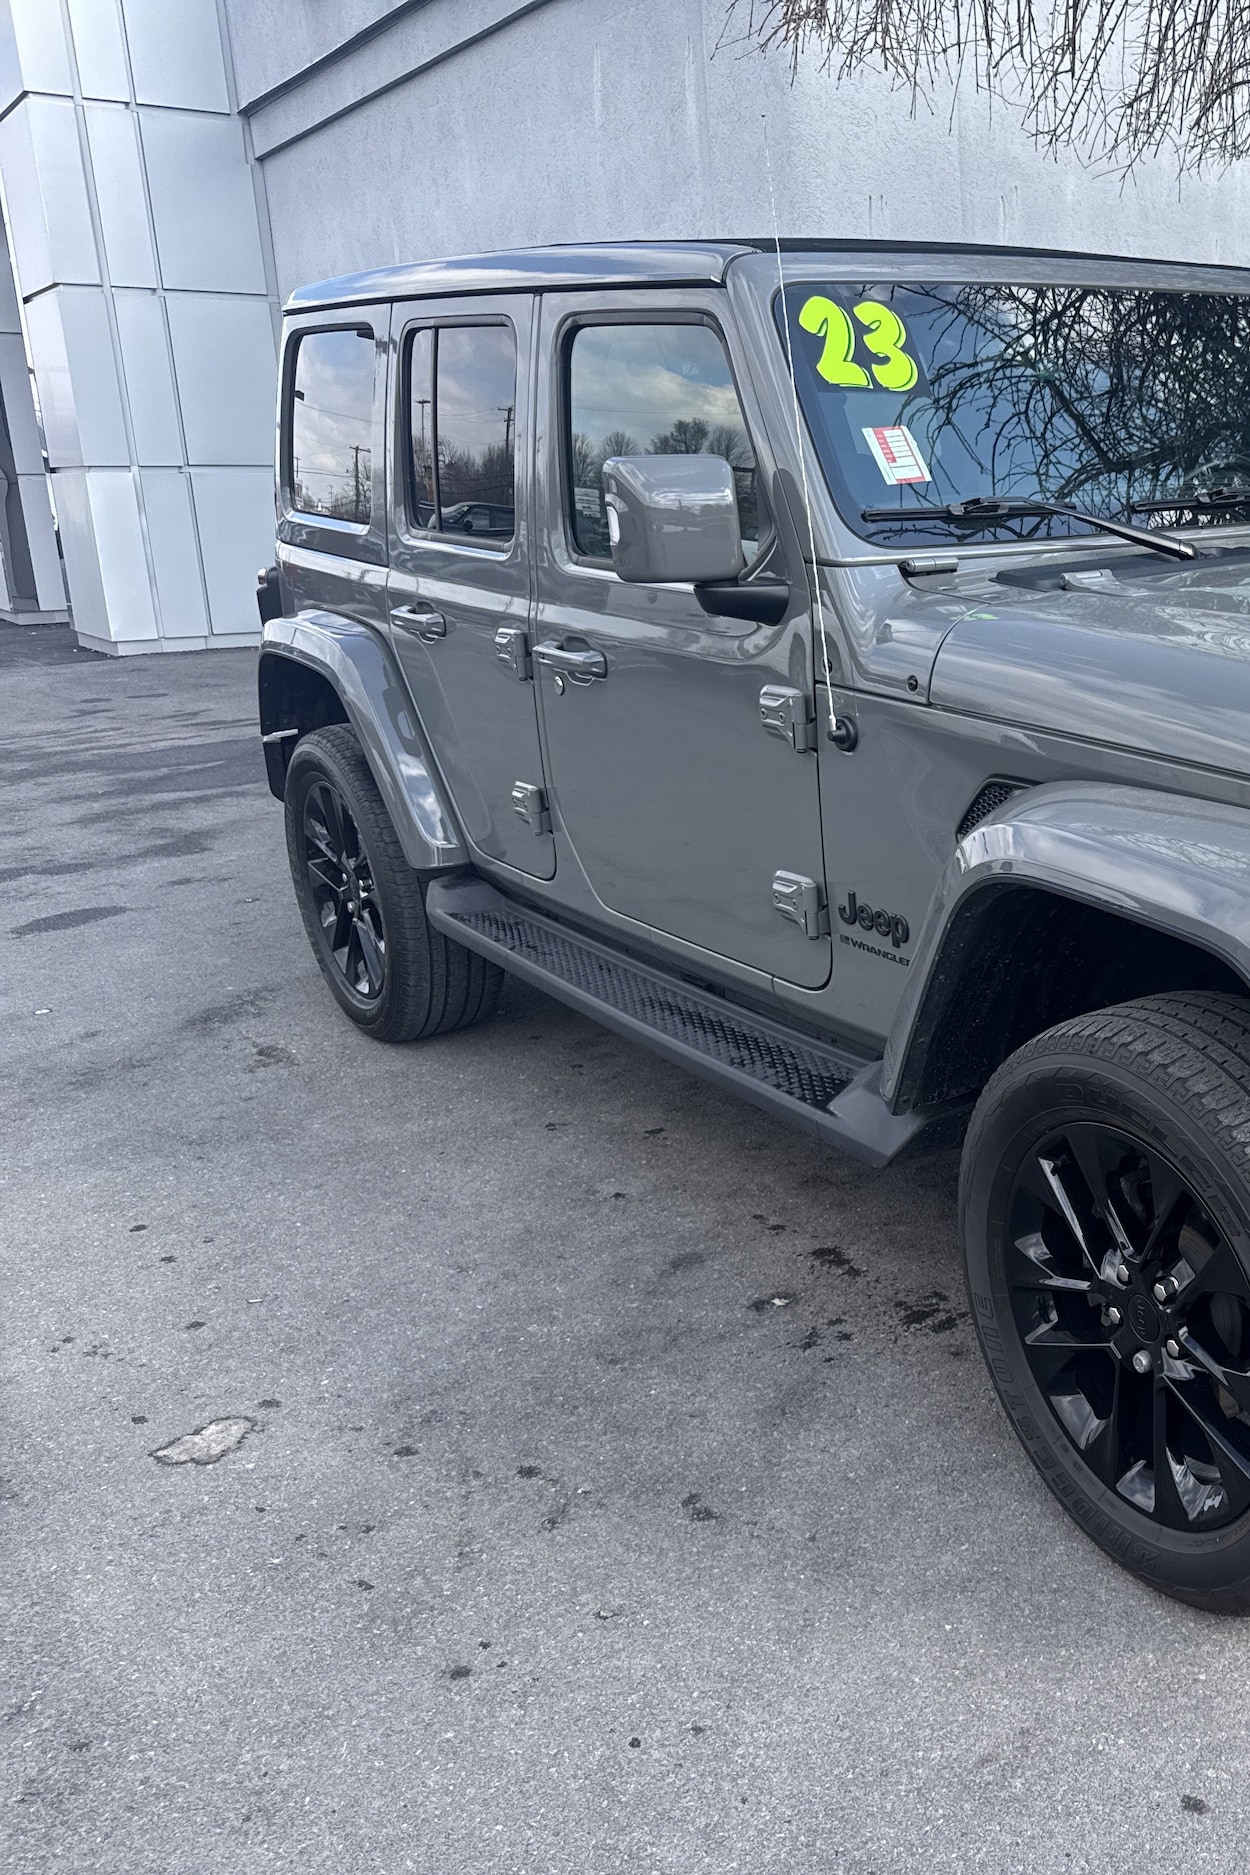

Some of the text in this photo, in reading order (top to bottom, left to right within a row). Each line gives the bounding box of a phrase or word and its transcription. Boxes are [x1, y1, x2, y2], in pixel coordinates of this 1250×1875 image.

[798, 295, 919, 391] 23
[838, 890, 910, 949] Jeep
[973, 1293, 1161, 1574] BRIDGESTONE
